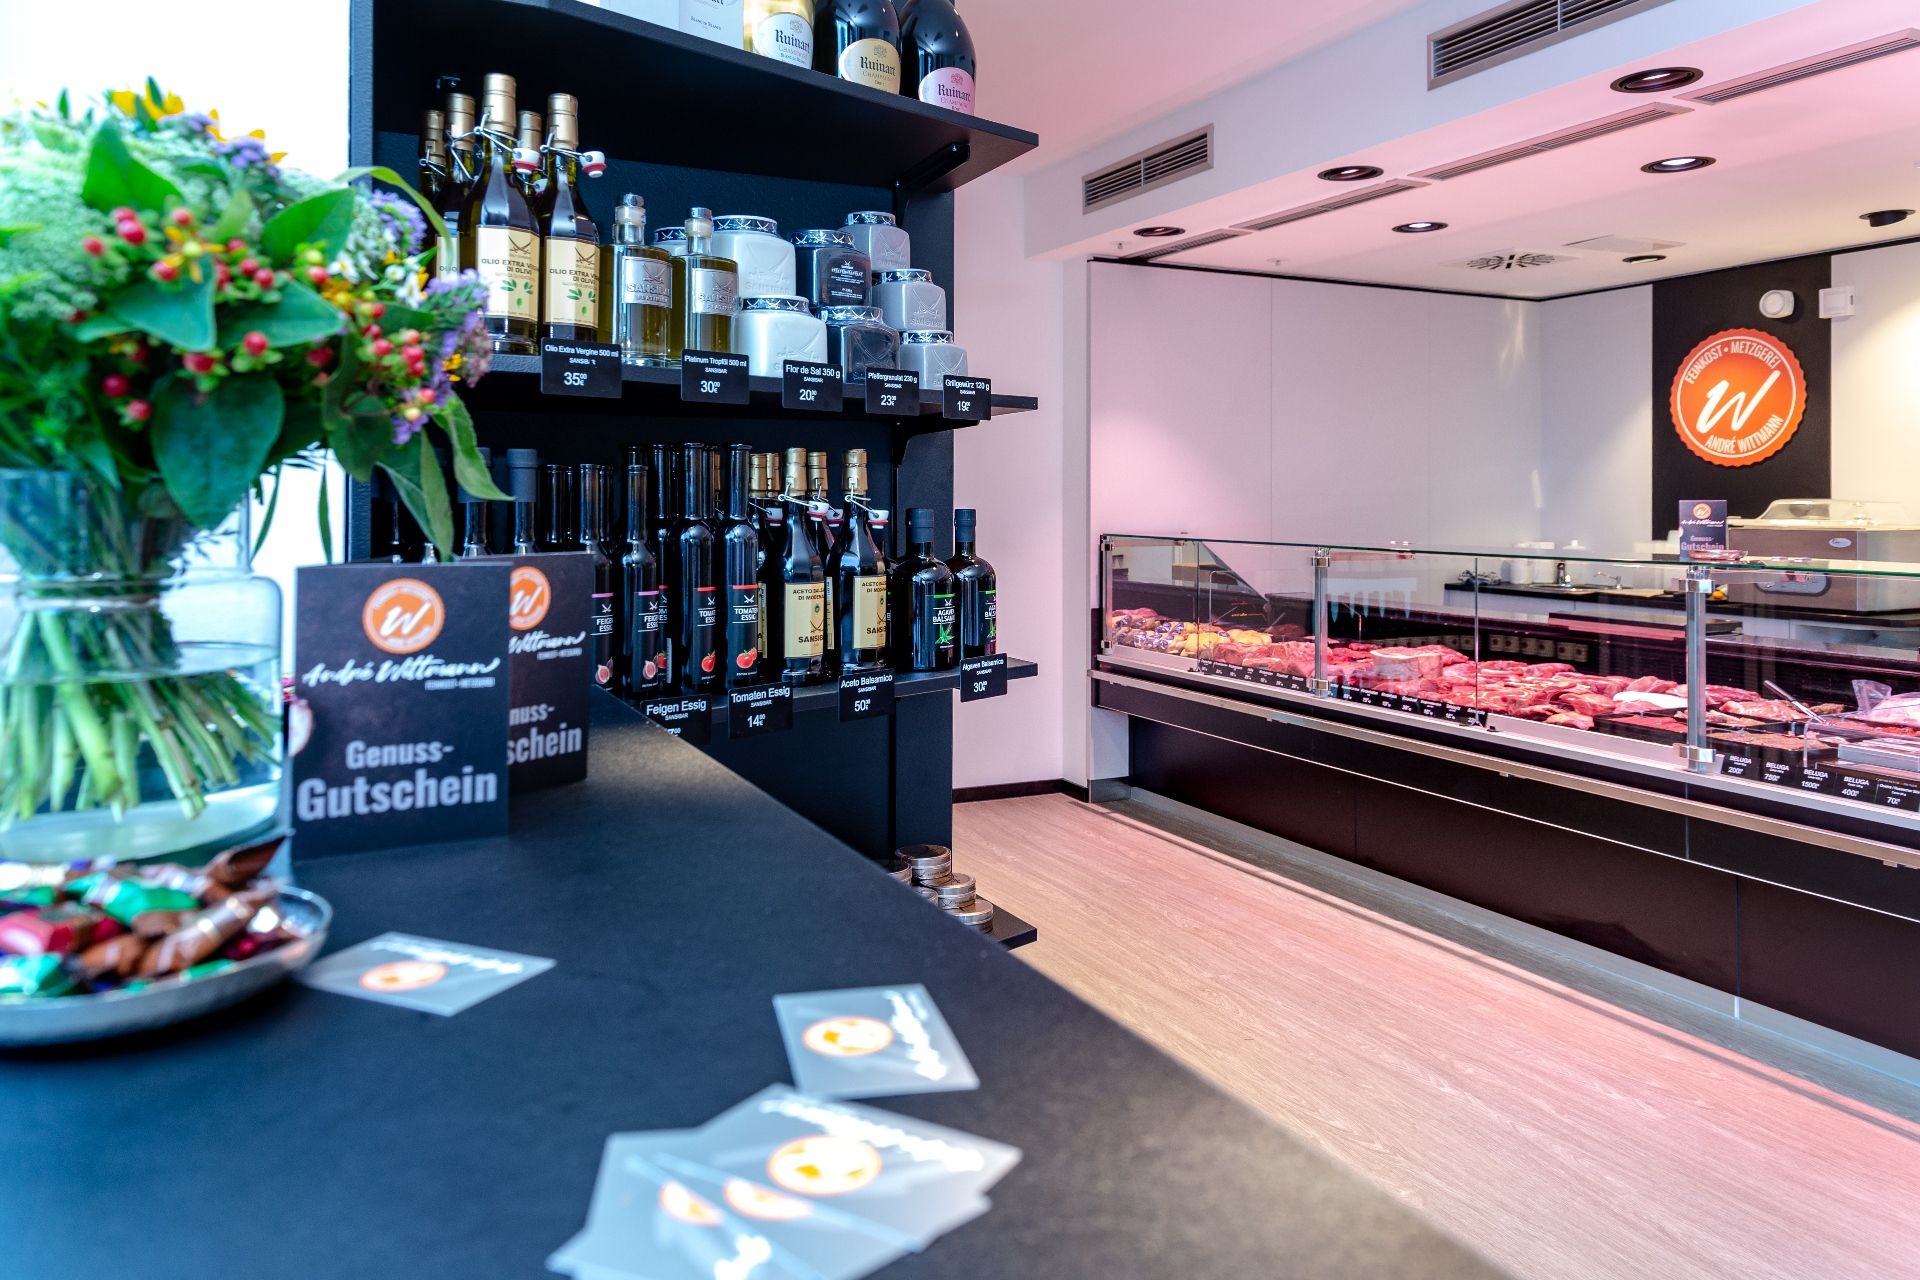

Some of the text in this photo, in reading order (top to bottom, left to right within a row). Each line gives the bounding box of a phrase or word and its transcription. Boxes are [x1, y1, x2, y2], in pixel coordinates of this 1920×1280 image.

[775, 29, 810, 54] Ruinart
[860, 55, 896, 77] Ruinart
[938, 83, 971, 103] Ruinart
[559, 345, 575, 354] Extra
[575, 346, 599, 357] Vergine
[599, 349, 611, 357] 500
[684, 354, 709, 364] Platinum
[728, 359, 740, 367] 500
[1684, 340, 1783, 385] FEINKOST METZGEREI
[786, 364, 799, 374] Flor
[800, 365, 810, 375] de
[810, 366, 822, 376] Sal
[822, 367, 835, 377] 350
[835, 370, 841, 379] g
[1704, 413, 1785, 454] ANDRÉ WITTMANN
[798, 634, 824, 644] SANSIB
[840, 673, 893, 689] Aceto Balsamico
[730, 686, 791, 704] Tomaten Essig
[509, 703, 556, 727] nuss-
[646, 699, 707, 716] Feigen Essig
[506, 722, 583, 766] schein
[345, 739, 454, 770] Genuss-
[1729, 755, 1752, 764] BELUGA
[1765, 761, 1790, 771] BELUGA
[1803, 768, 1829, 779] BELUGA
[1843, 776, 1870, 786] BELUGA
[296, 764, 498, 822] Gutschein
